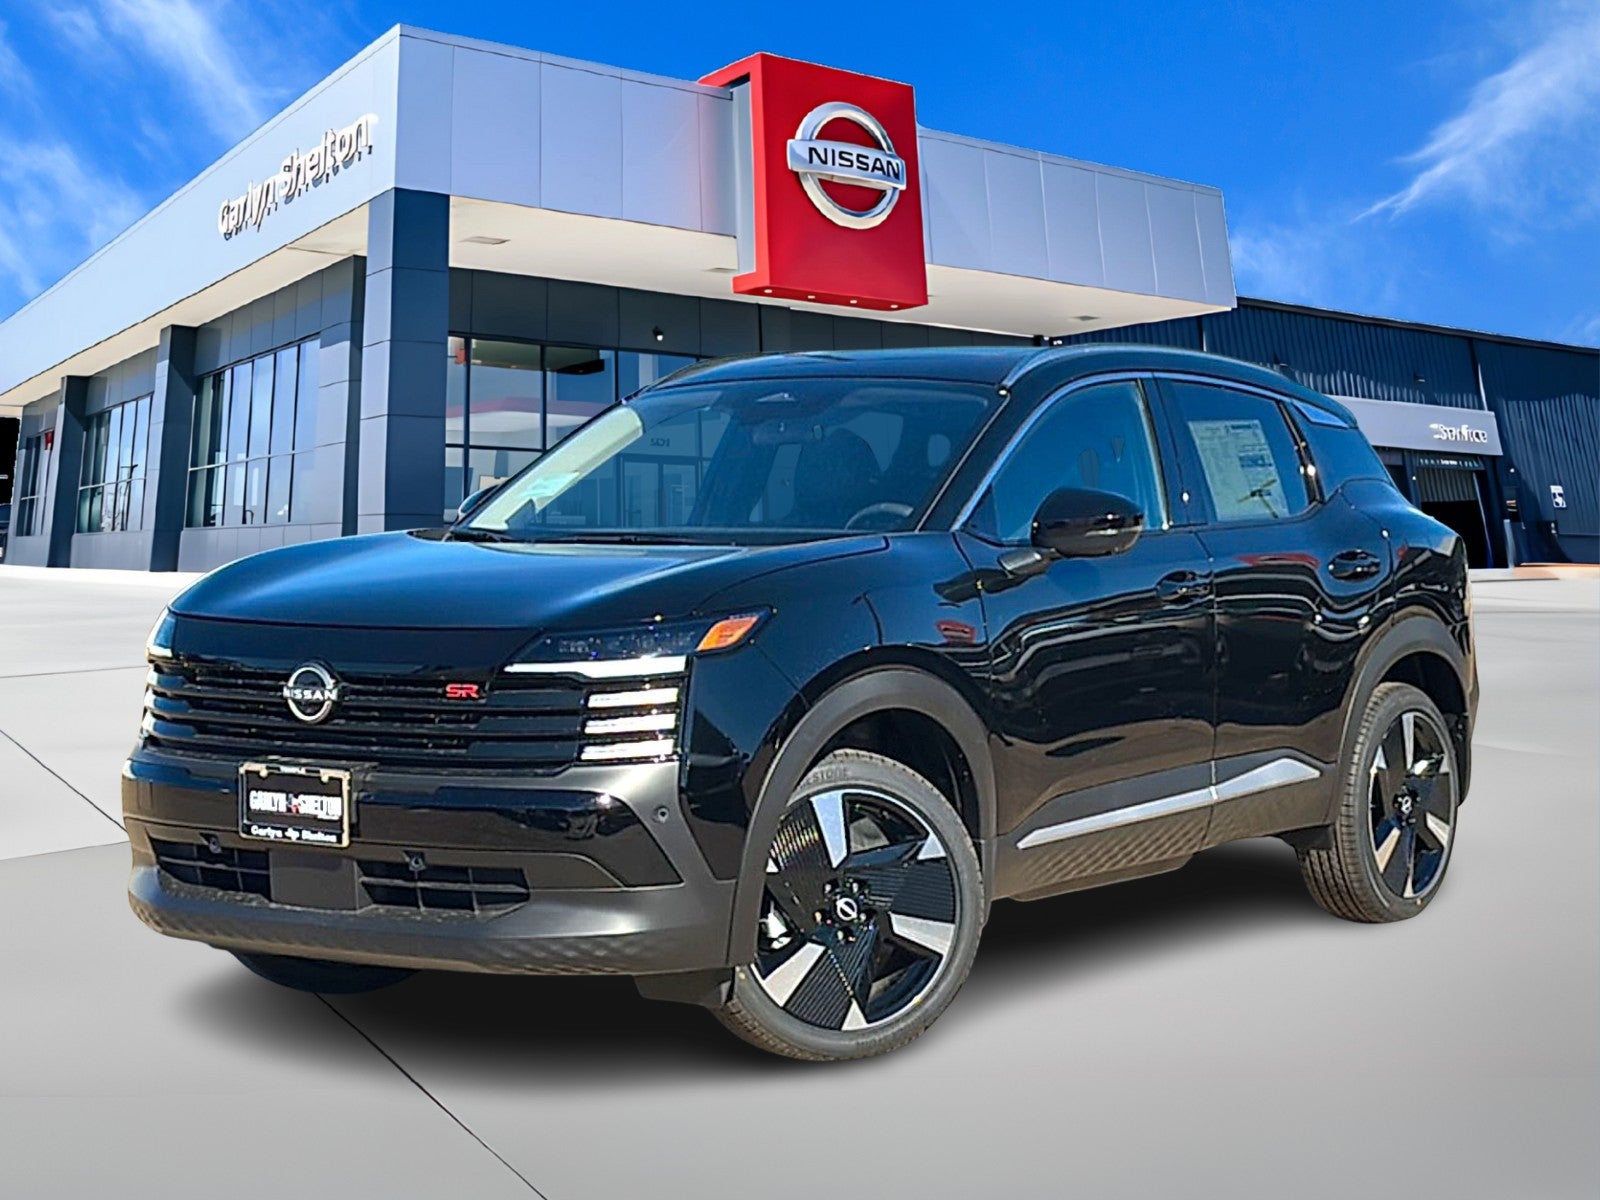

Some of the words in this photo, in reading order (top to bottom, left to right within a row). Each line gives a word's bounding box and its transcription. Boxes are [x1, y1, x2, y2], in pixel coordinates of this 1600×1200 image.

[279, 114, 374, 199] Shelton
[808, 146, 900, 181] NISSAN
[1430, 423, 1488, 443] Service
[283, 686, 338, 701] NISSAN
[446, 683, 479, 698] SR
